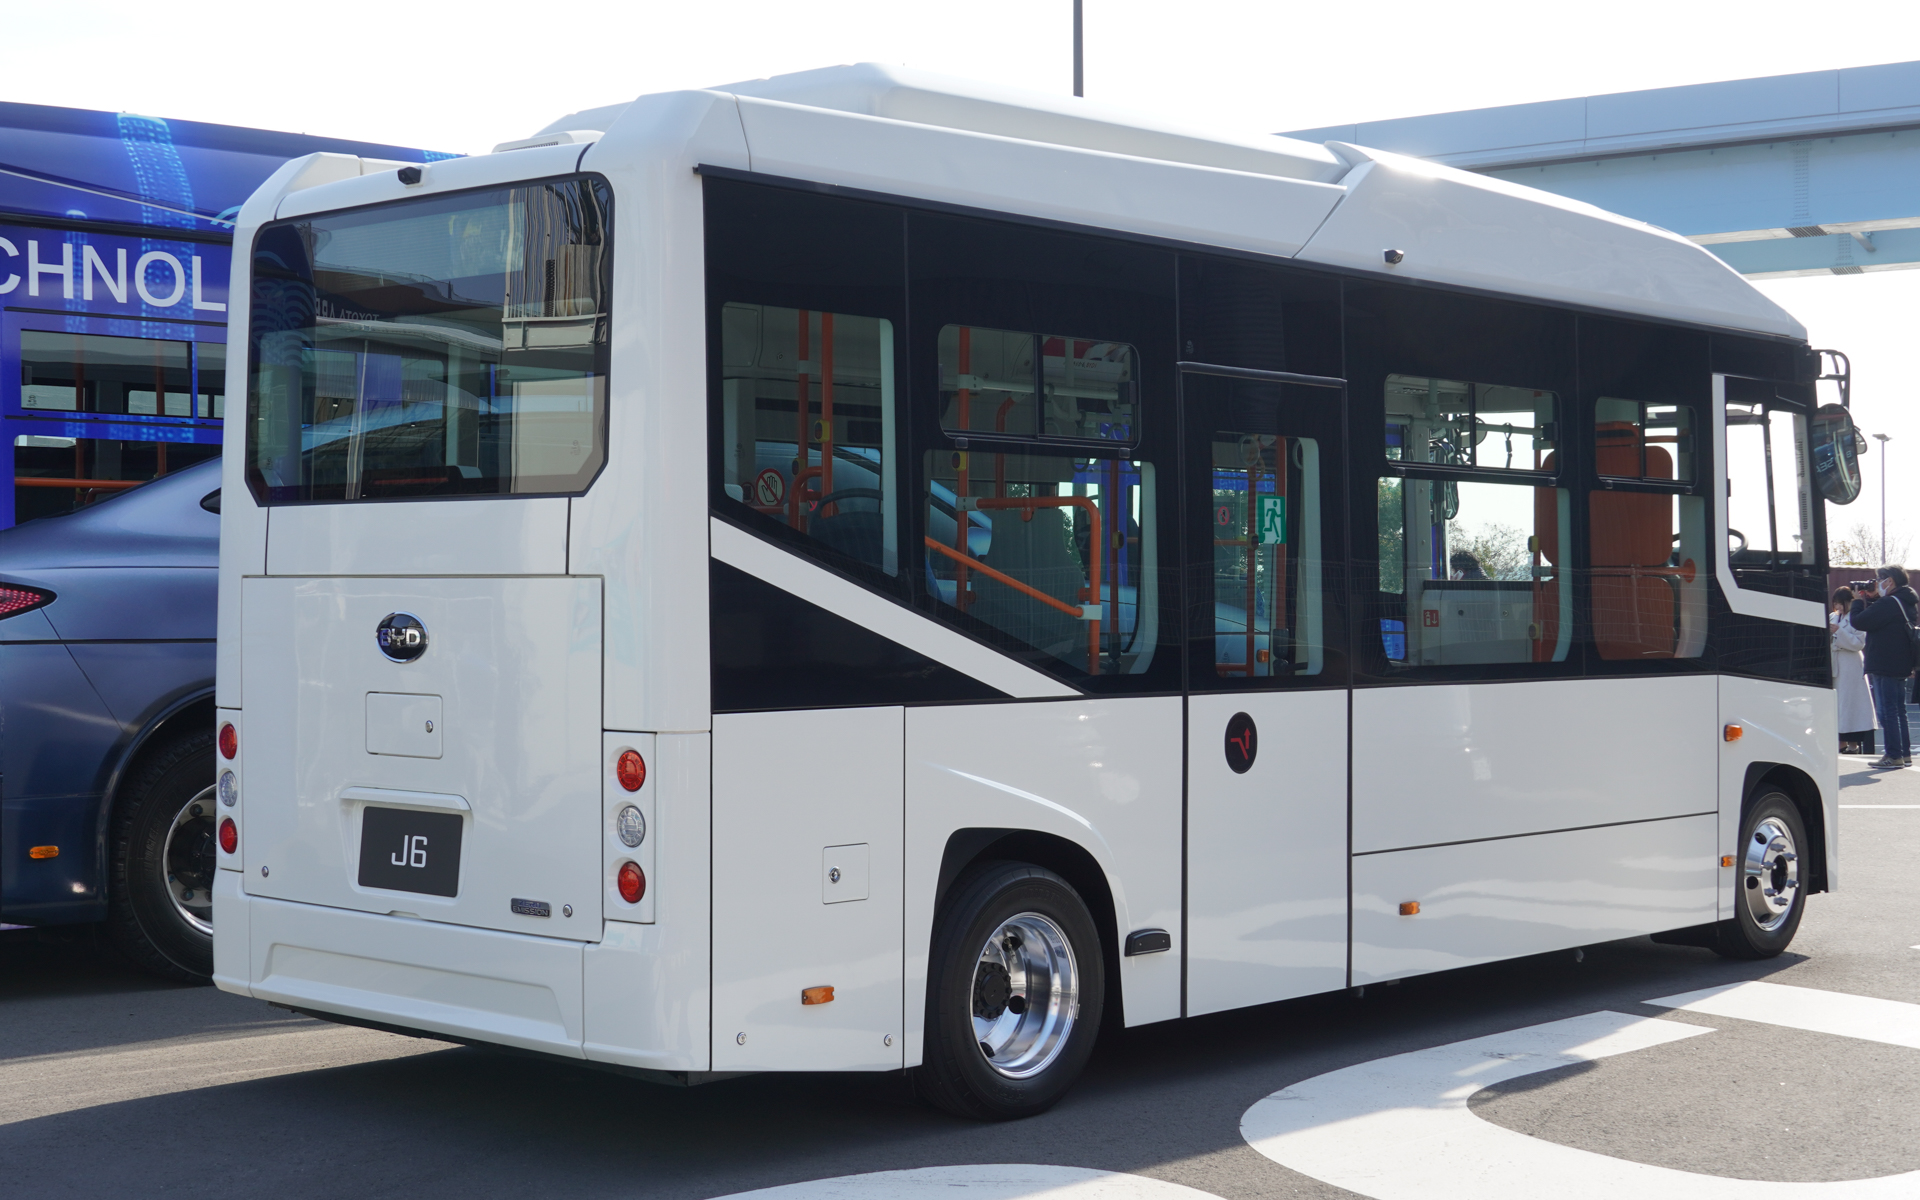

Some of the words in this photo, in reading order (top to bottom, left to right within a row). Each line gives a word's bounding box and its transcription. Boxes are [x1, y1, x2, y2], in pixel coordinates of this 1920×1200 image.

[380, 628, 421, 647] BYD
[391, 834, 428, 868] J6
[512, 905, 549, 916] EMISSION
